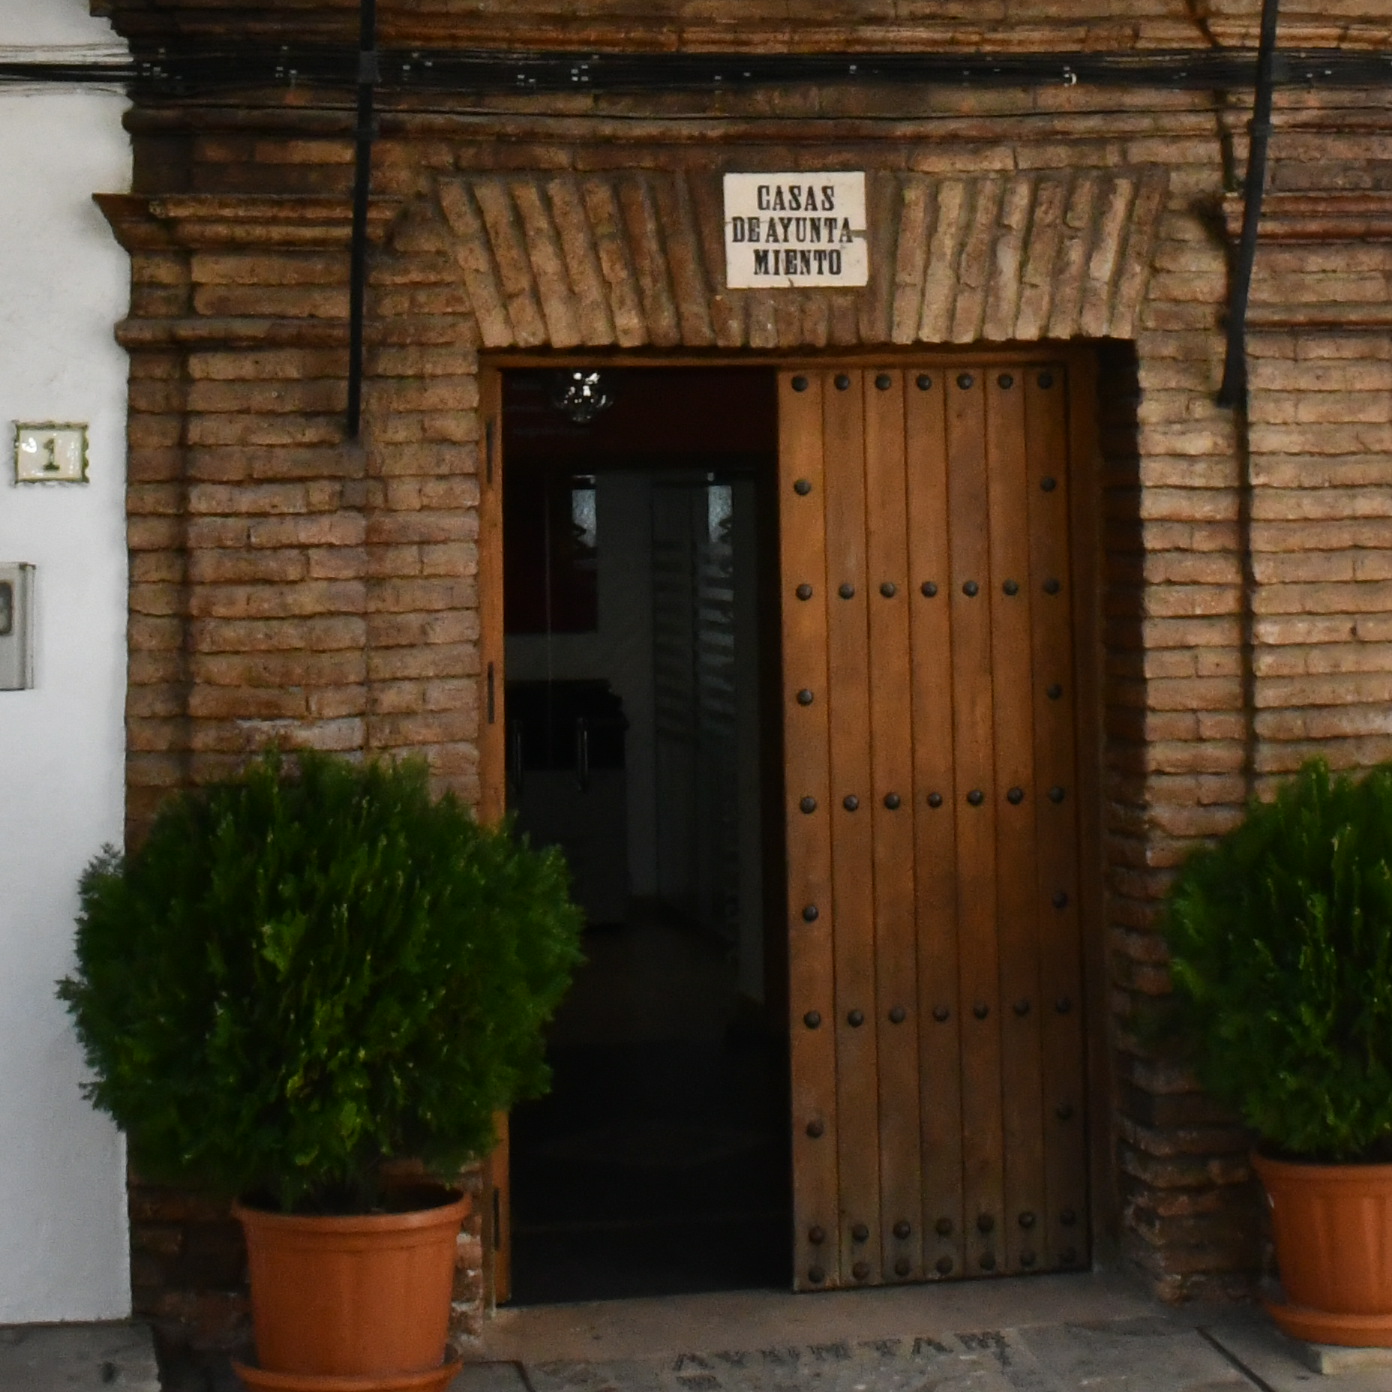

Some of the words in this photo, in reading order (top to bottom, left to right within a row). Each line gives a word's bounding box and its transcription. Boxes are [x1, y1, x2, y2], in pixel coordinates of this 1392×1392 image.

[757, 185, 835, 211] CASAS
[731, 216, 760, 243] DE
[765, 217, 854, 243] AYUNTA
[753, 249, 842, 276] MIENTO
[43, 437, 61, 471] 1
